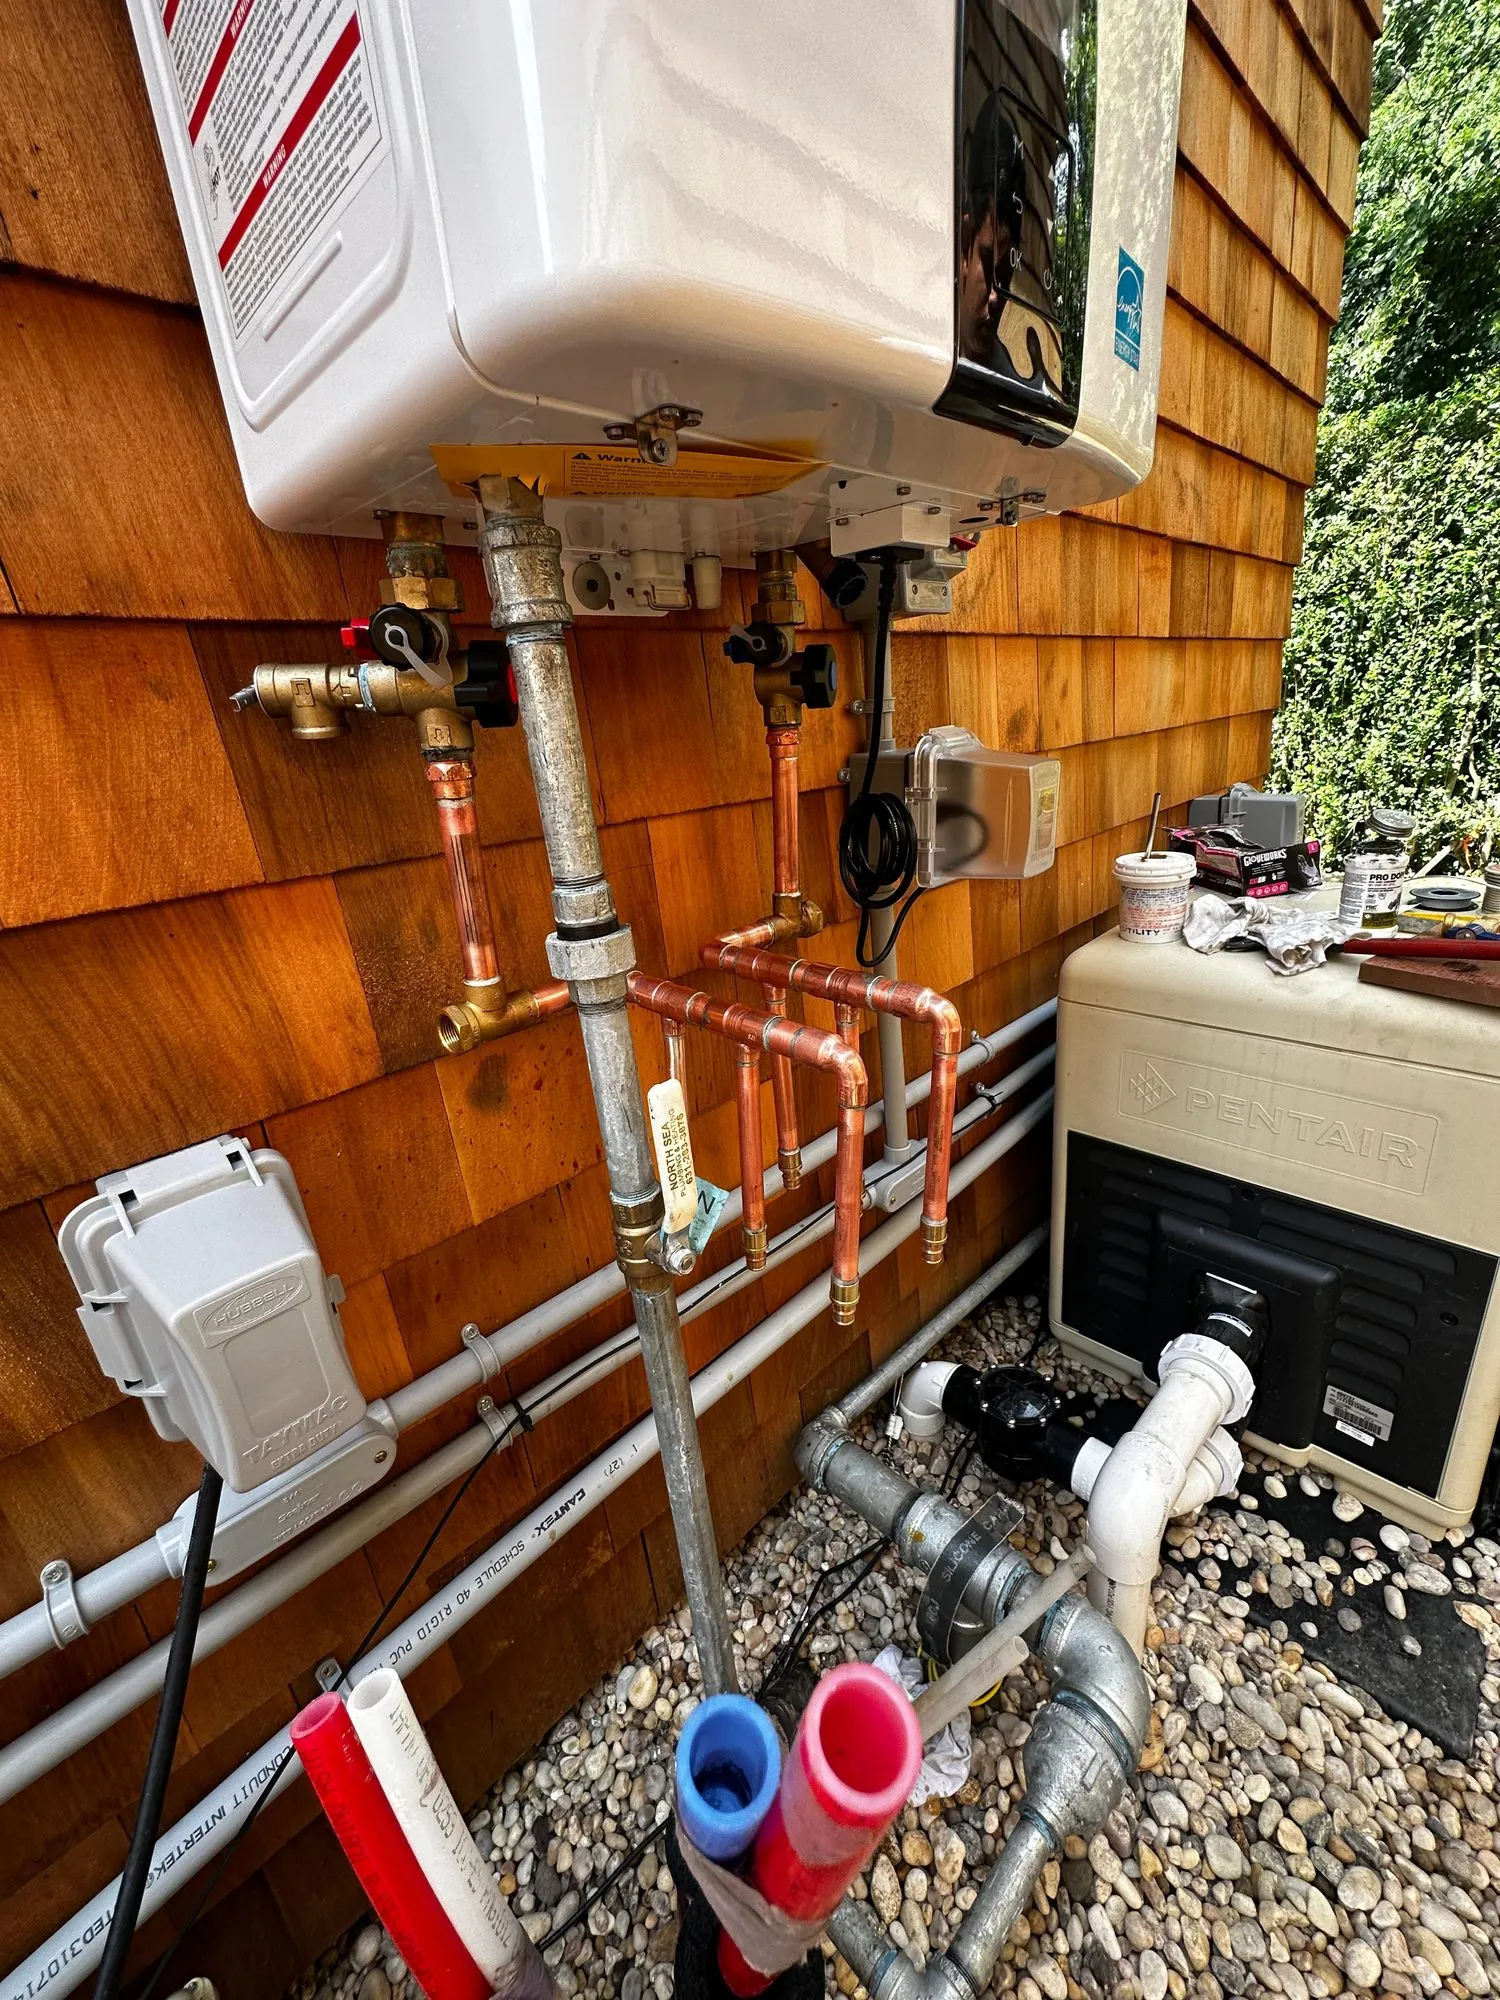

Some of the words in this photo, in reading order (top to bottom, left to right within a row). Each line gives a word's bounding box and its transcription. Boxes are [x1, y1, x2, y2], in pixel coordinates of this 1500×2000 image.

[262, 144, 287, 189] WARNING
[1009, 247, 1023, 272] OK
[1243, 848, 1287, 866] GLOVEWORKS
[661, 1121, 671, 1145] SEA
[671, 1108, 680, 1147] HEATING
[1185, 1085, 1422, 1170] PENTAIR
[666, 1147, 679, 1191] NORTH
[674, 1153, 688, 1198] PLUMBING
[215, 1280, 295, 1327] HUBBELL
[241, 1395, 350, 1462] TAYMAC
[270, 1442, 307, 1471] EXTRA
[308, 1423, 339, 1455] DUTY
[296, 1502, 333, 1531] LOCATION
[475, 1540, 525, 1589] SCHEDULE
[942, 1531, 982, 1582] SILICONE
[457, 1590, 471, 1605] 40
[417, 1605, 452, 1641] RIGID
[389, 1643, 413, 1666] PVC
[226, 1747, 297, 1808] CONDUIT
